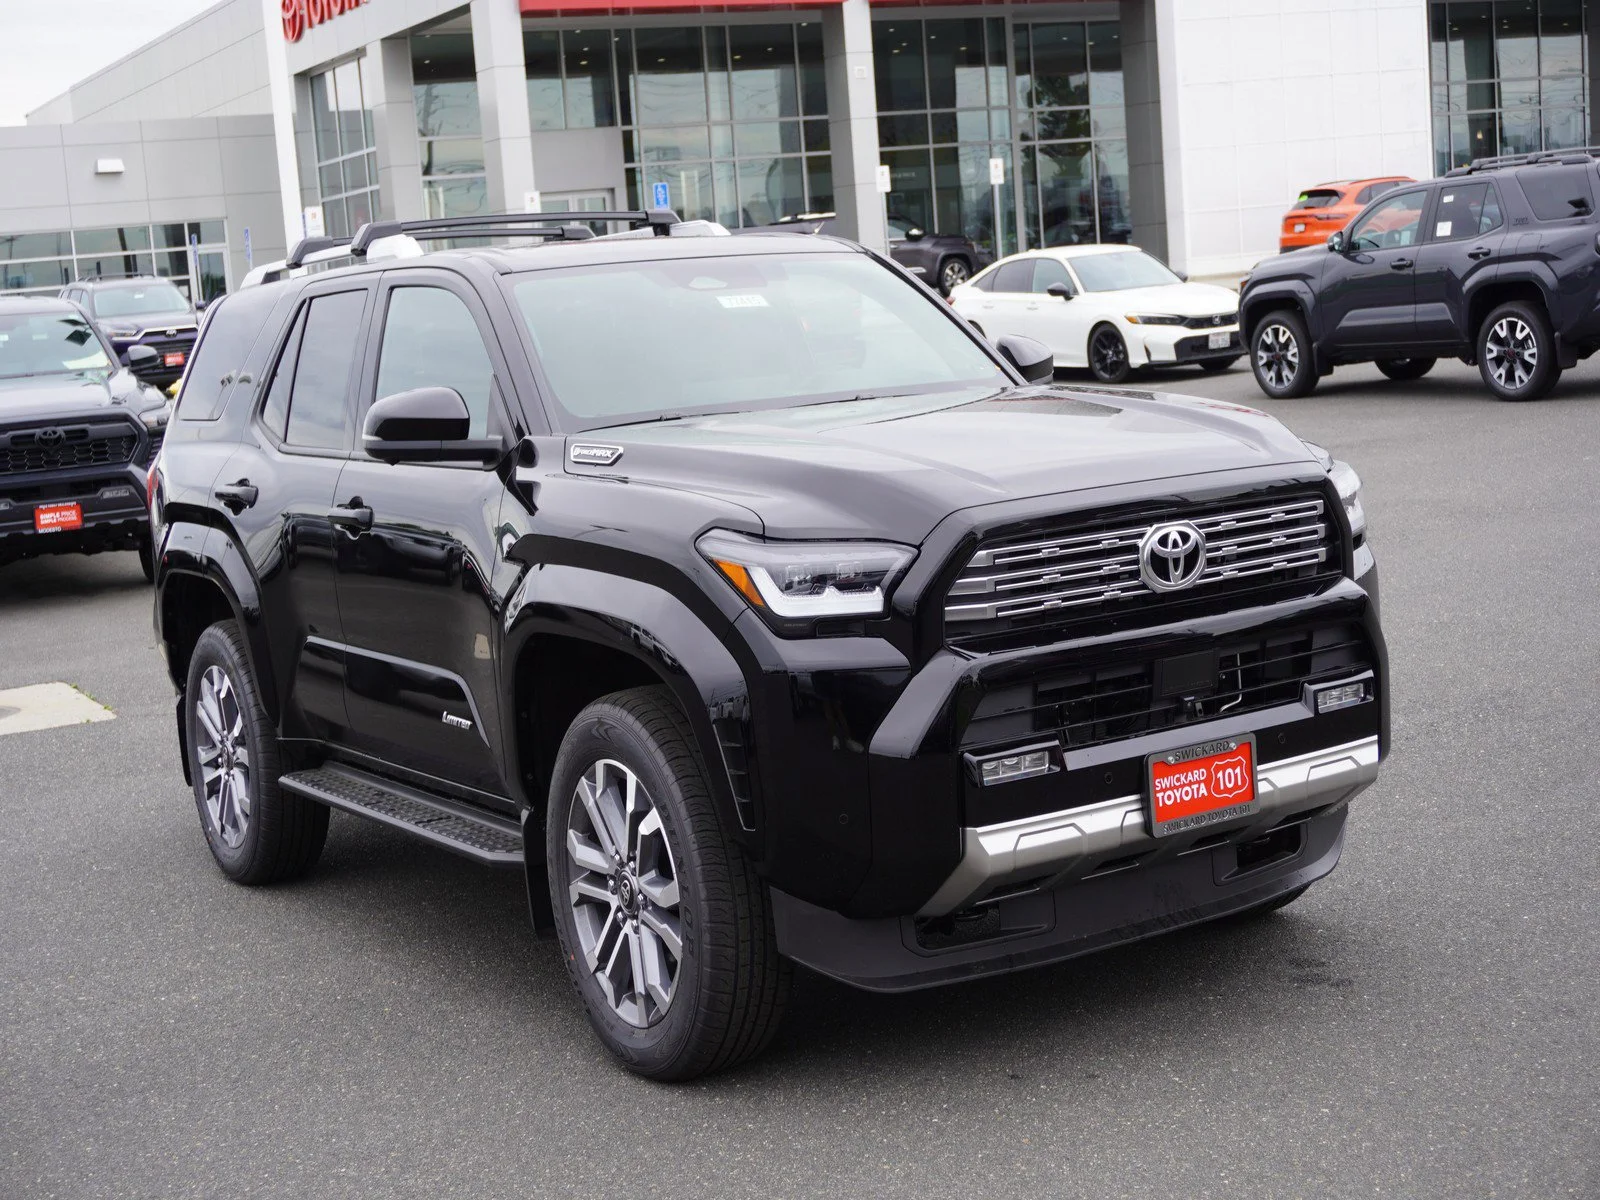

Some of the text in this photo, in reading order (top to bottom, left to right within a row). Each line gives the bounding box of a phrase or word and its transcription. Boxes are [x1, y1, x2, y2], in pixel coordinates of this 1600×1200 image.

[1174, 741, 1230, 761] SWICKARD
[1155, 768, 1207, 791] SWICKARD
[1217, 766, 1242, 790] 101
[1156, 783, 1208, 807] TOYOTA
[1163, 804, 1251, 834] SWICKARD TOYOTA 101
